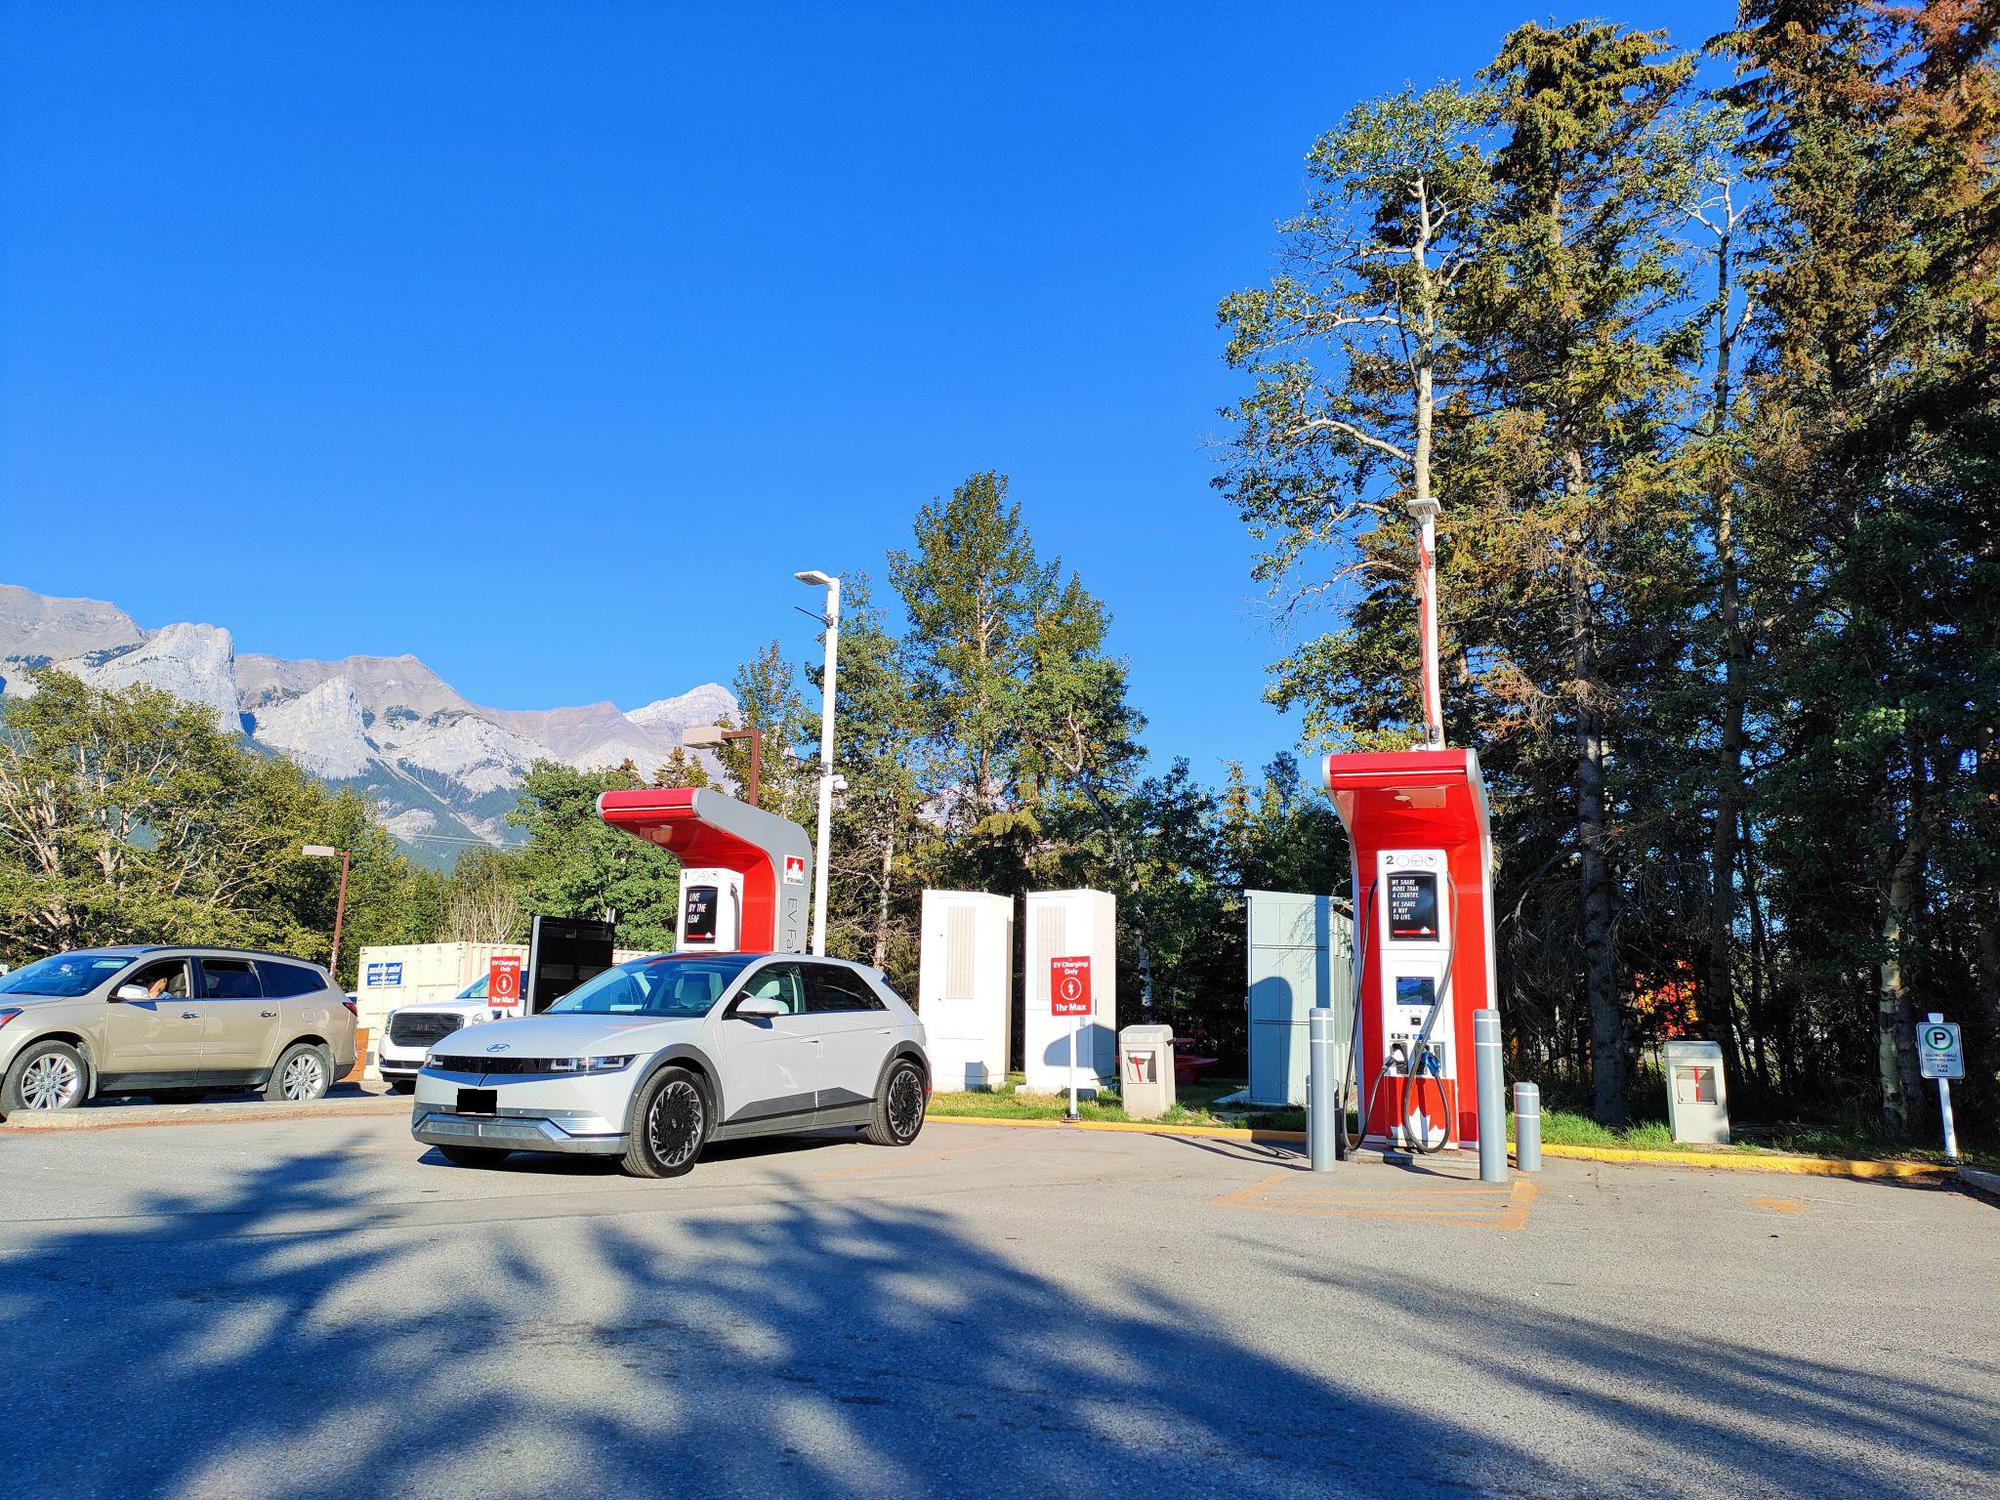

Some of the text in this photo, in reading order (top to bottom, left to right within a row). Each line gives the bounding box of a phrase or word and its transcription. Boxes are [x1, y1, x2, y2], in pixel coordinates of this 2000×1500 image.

[1386, 855, 1394, 865] 2
[689, 893, 700, 902] LIVE
[688, 904, 707, 912] BY THE
[787, 898, 798, 923] EV
[688, 914, 700, 924] LEAF
[1068, 1004, 1086, 1012] Max
[1934, 1032, 1946, 1045] P
